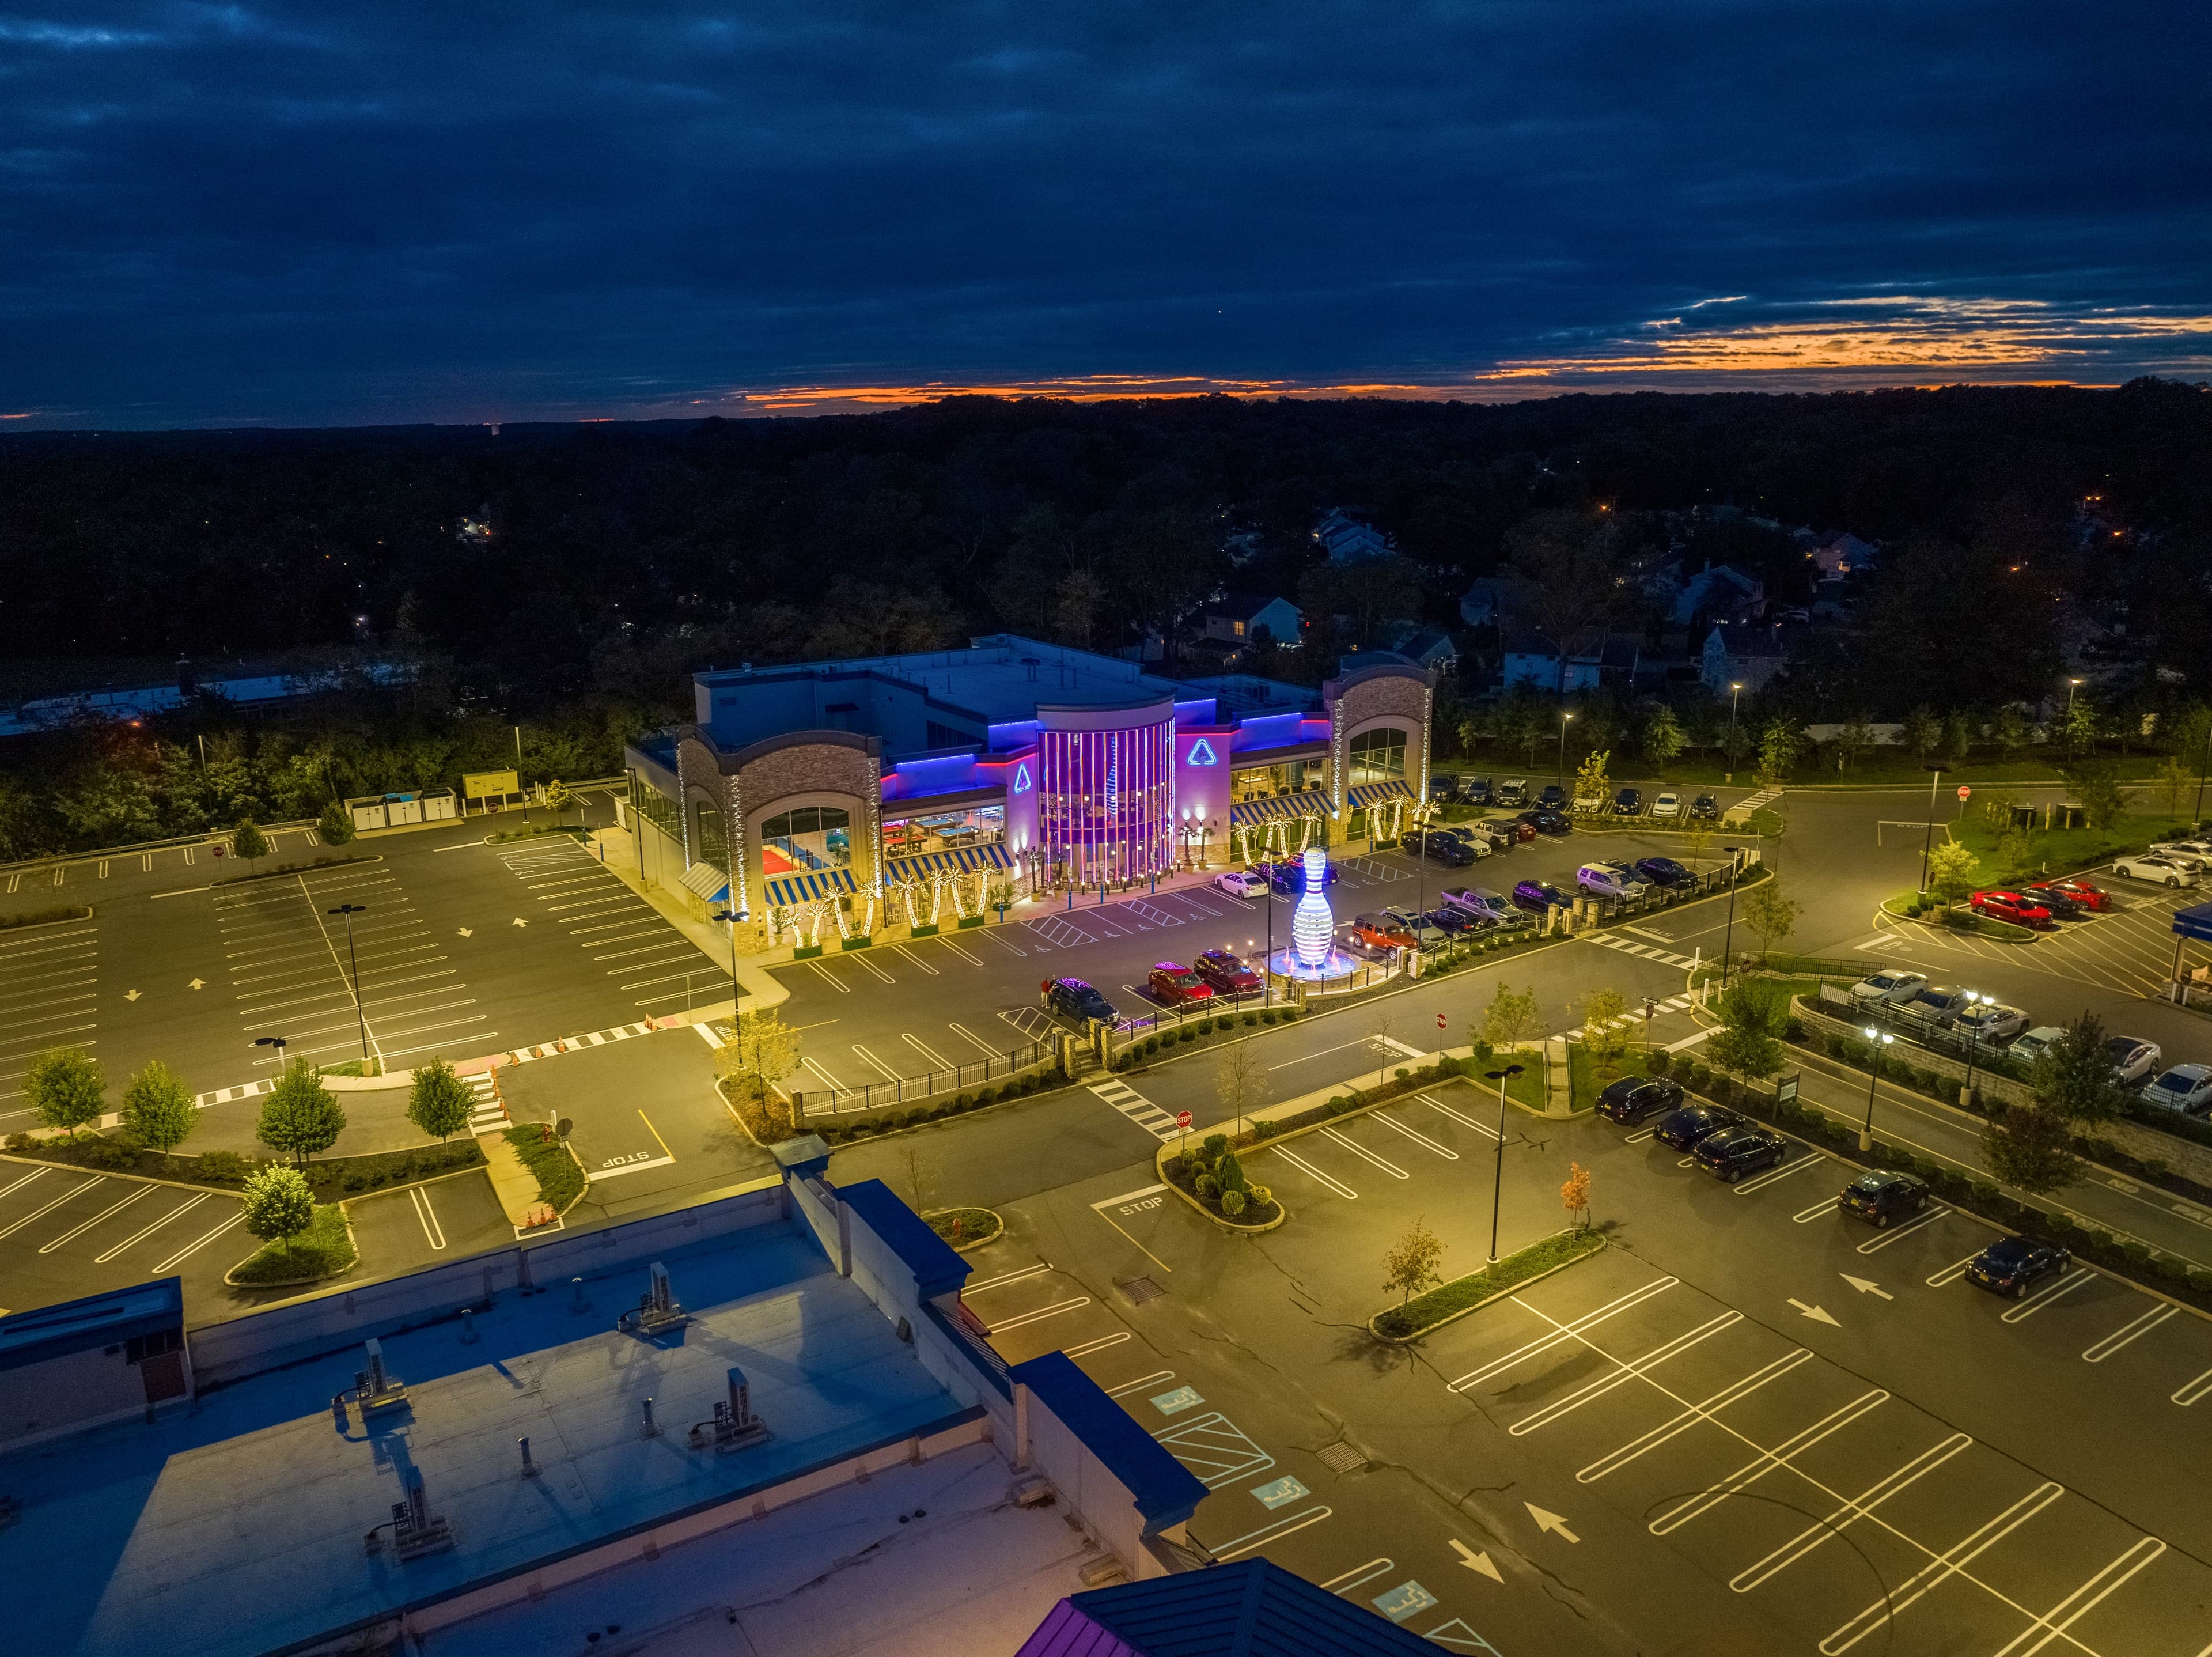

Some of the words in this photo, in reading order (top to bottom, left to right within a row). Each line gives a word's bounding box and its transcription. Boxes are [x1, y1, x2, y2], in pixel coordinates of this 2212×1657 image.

[1641, 927, 1674, 937] STOP
[1437, 1016, 1446, 1026] STOP
[1369, 1043, 1402, 1057] STOP
[1177, 1115, 1191, 1124] STOP
[603, 1151, 650, 1168] STOP
[1119, 1197, 1163, 1215] STOP
